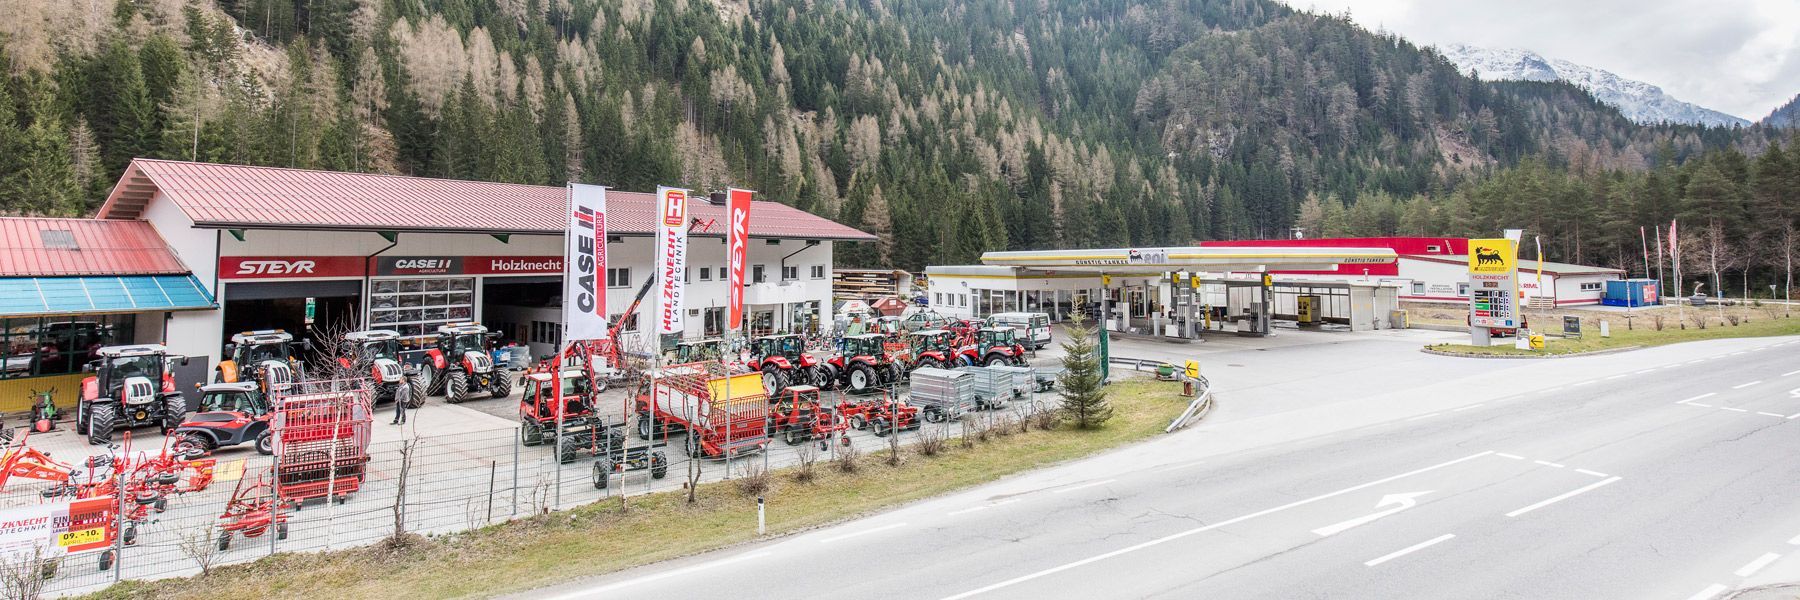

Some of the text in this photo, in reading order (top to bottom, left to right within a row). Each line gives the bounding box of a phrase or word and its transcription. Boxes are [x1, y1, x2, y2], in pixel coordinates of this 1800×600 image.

[667, 198, 682, 218] H
[597, 213, 605, 267] AGRICULTURE
[395, 259, 437, 269] CASE
[491, 259, 562, 271] Holzknecht
[731, 207, 746, 311] STEYR
[1144, 249, 1165, 264] eni
[236, 260, 316, 275] STEYR
[577, 234, 594, 314] CASE
[663, 228, 676, 331] HOLZKNECHT
[673, 236, 683, 323] LANDTECHNIK
[53, 511, 104, 523] EINLADUNG
[82, 517, 107, 525] MESSE
